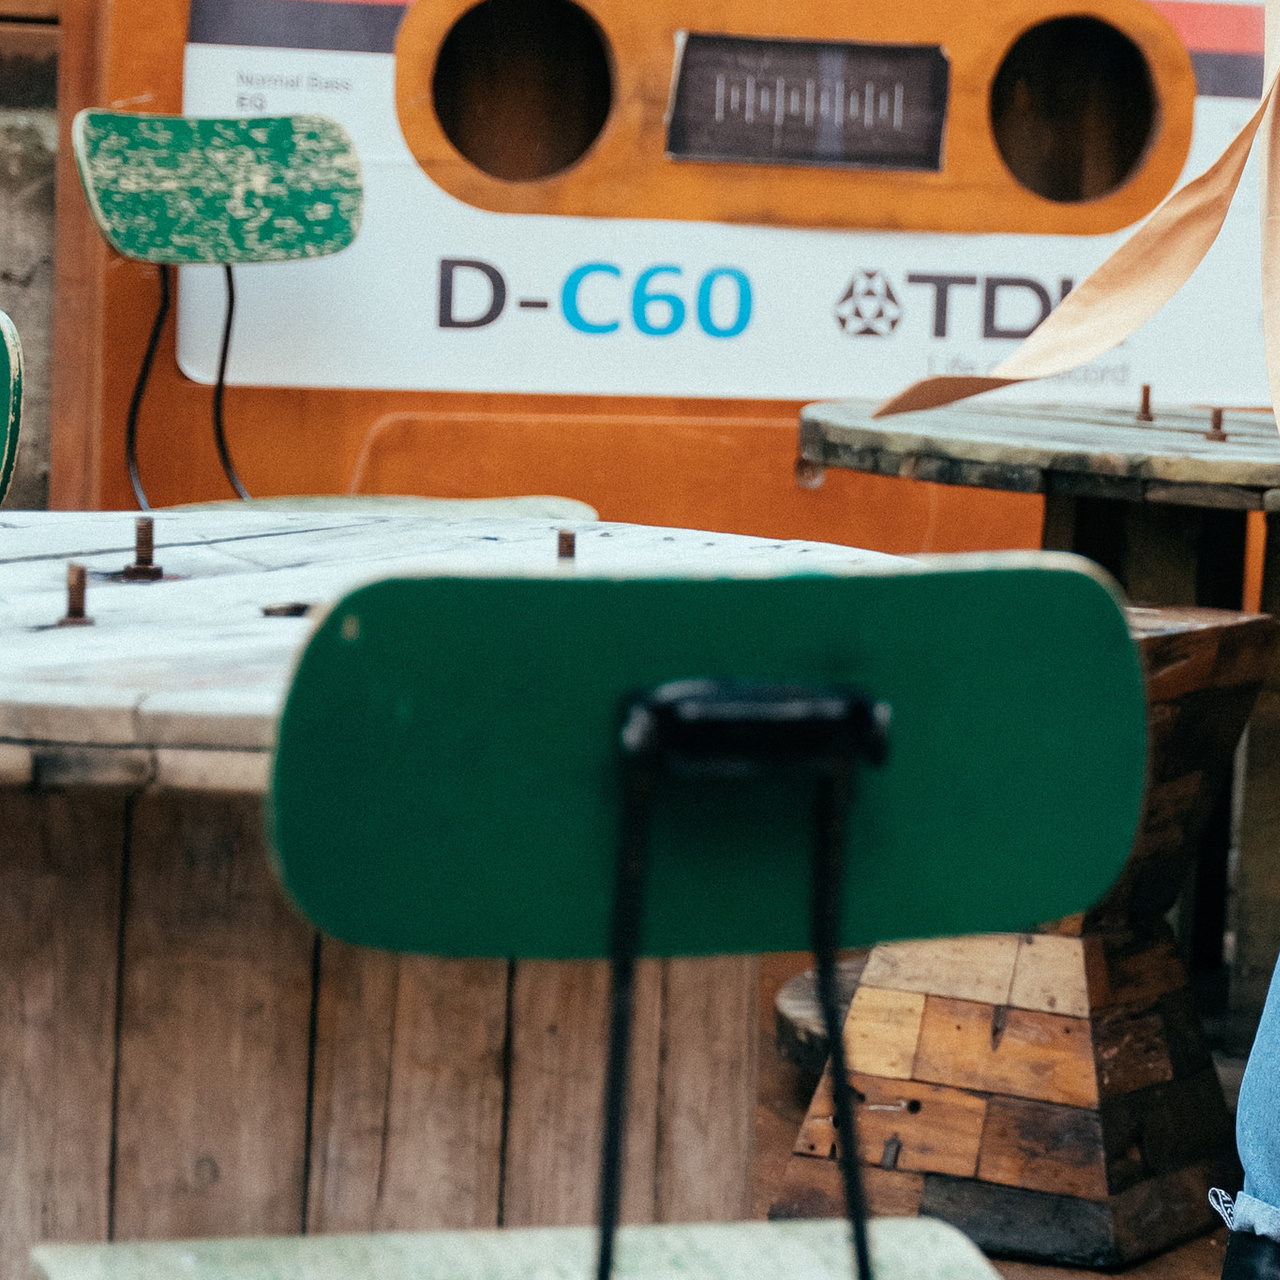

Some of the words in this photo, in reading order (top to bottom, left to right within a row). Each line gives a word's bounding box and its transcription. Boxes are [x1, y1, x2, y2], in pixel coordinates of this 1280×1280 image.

[235, 92, 266, 112] EQ
[437, 257, 754, 339] D-C60
[907, 273, 1082, 339] TD
